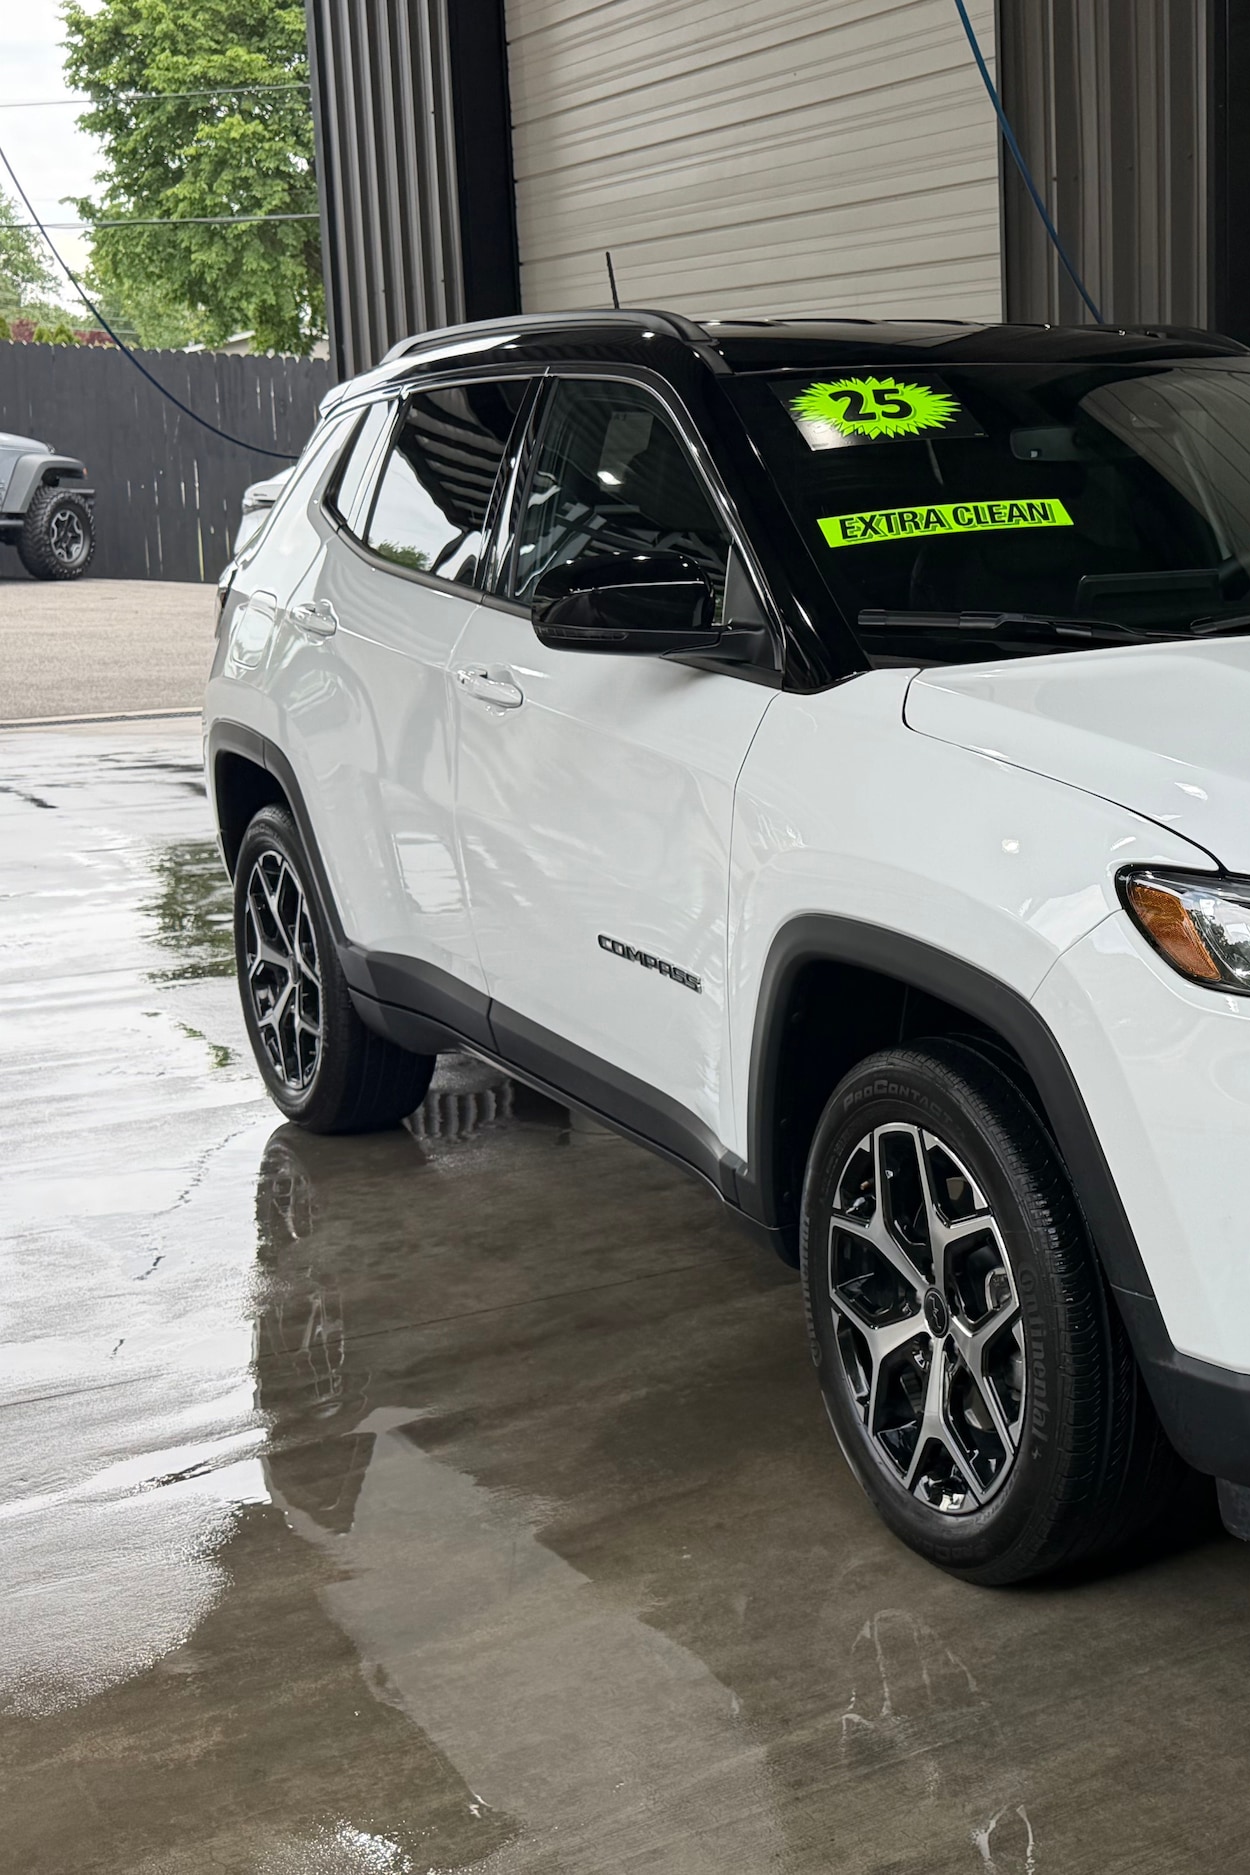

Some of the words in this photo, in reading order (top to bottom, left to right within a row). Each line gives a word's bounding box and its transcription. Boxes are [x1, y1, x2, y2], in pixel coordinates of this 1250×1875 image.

[828, 388, 915, 423] 25
[839, 508, 949, 542] EXTRA
[953, 501, 1053, 527] CLEAN
[597, 933, 702, 995] COMPASS
